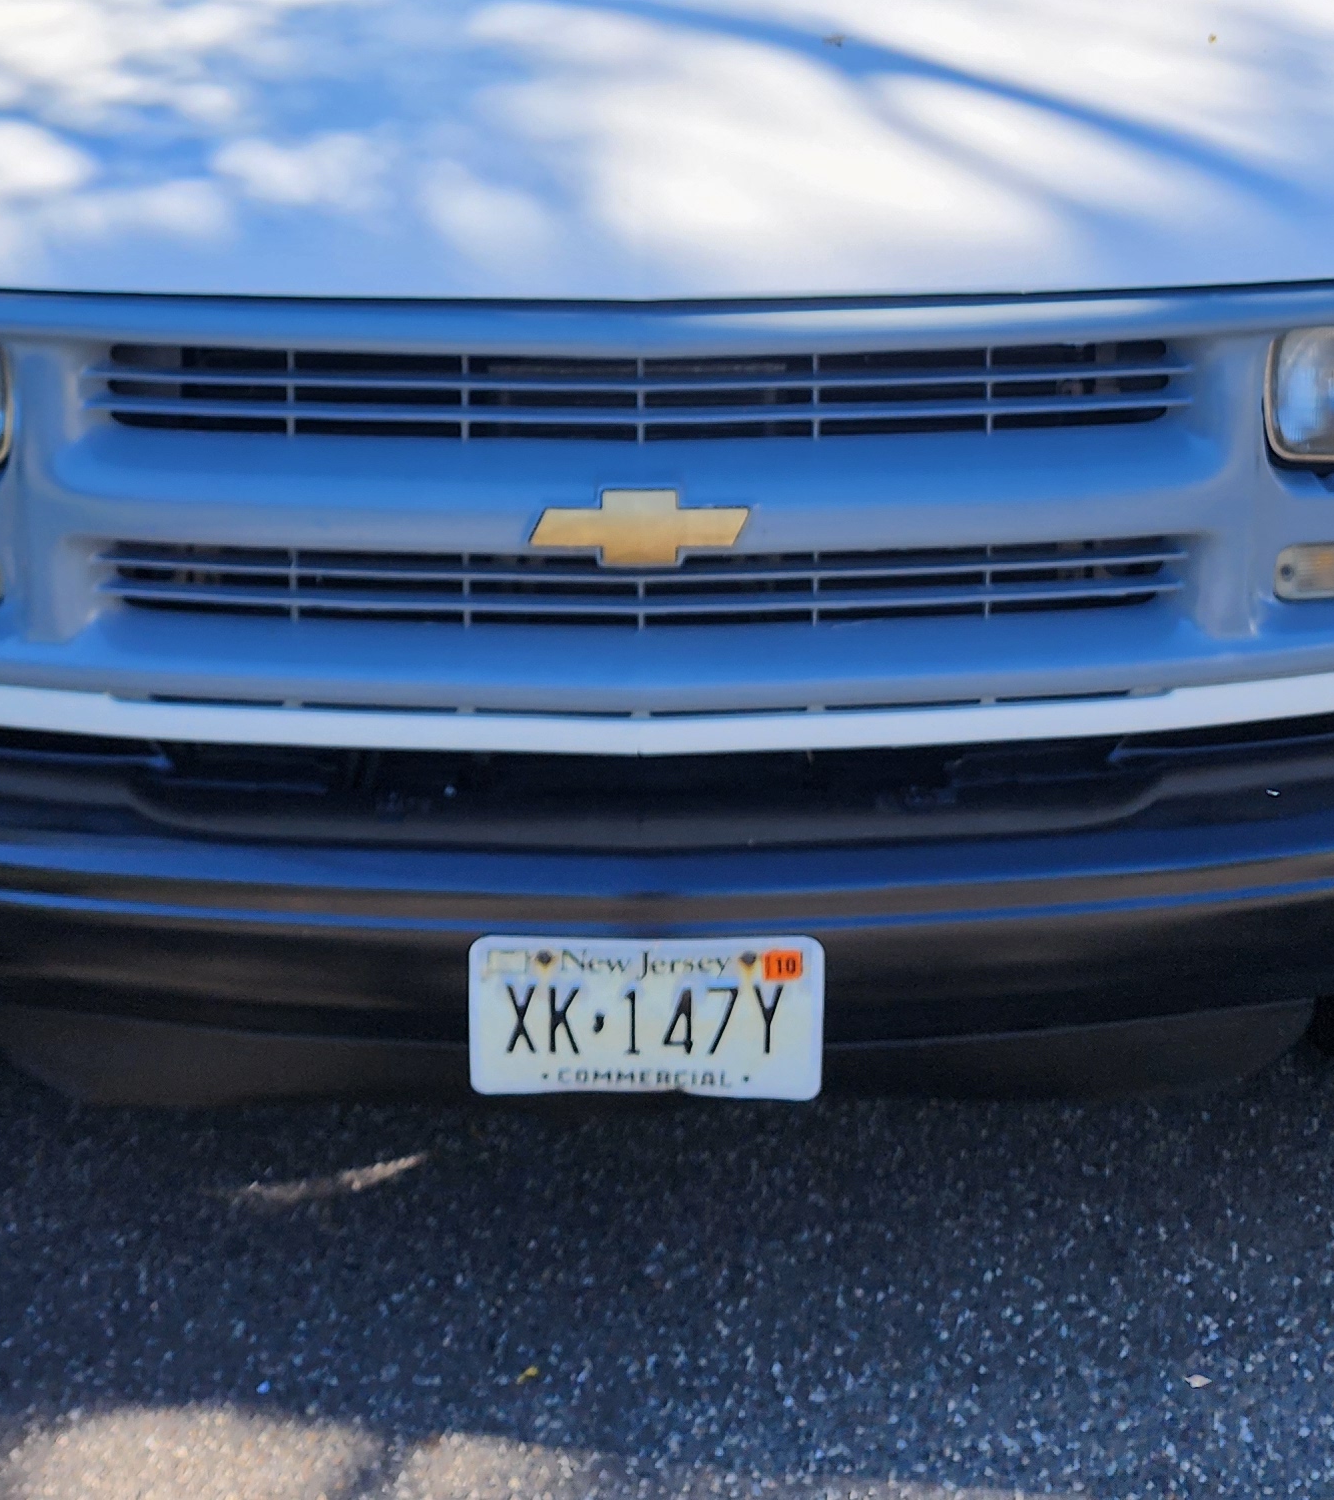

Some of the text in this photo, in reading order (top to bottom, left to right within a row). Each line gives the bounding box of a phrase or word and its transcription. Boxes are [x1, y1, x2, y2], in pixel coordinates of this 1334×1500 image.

[561, 949, 732, 981] New Jersey
[777, 956, 797, 975] 10
[557, 1068, 734, 1091] COMMERCIAL
